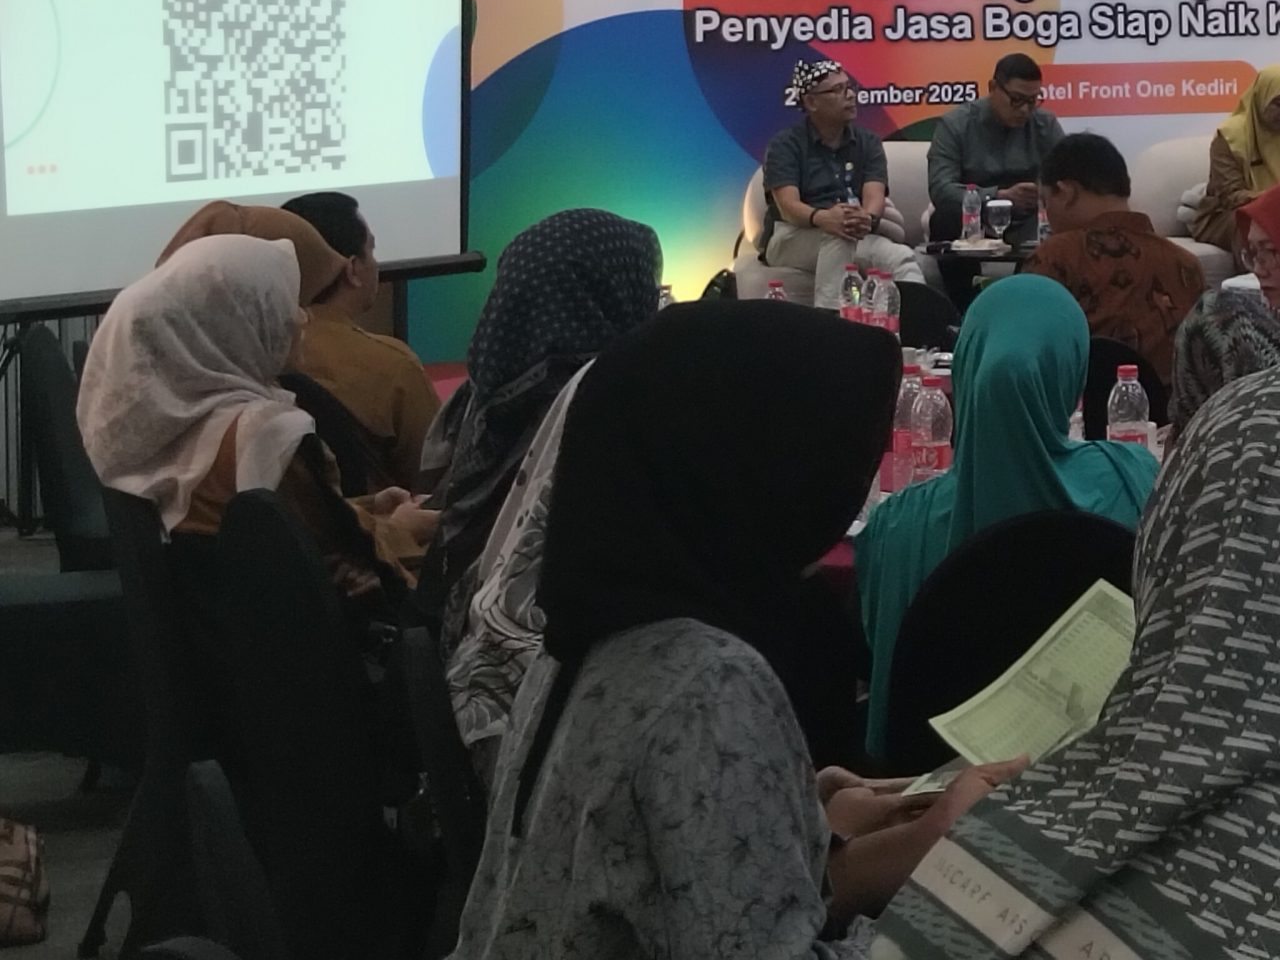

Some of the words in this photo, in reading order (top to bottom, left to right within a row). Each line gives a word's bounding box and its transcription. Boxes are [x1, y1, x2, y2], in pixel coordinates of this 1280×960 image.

[694, 7, 873, 50] Penyedia
[884, 7, 972, 41] Jasa
[984, 5, 1081, 46] Boga
[1090, 3, 1170, 44] Siap
[1180, 1, 1259, 37] Naik
[784, 87, 800, 106] 2
[857, 83, 923, 105] ember
[928, 83, 977, 103] 2025
[1036, 82, 1072, 101] otel
[1078, 80, 1131, 100] Front
[1136, 79, 1175, 98] One
[1181, 77, 1238, 97] Kediri
